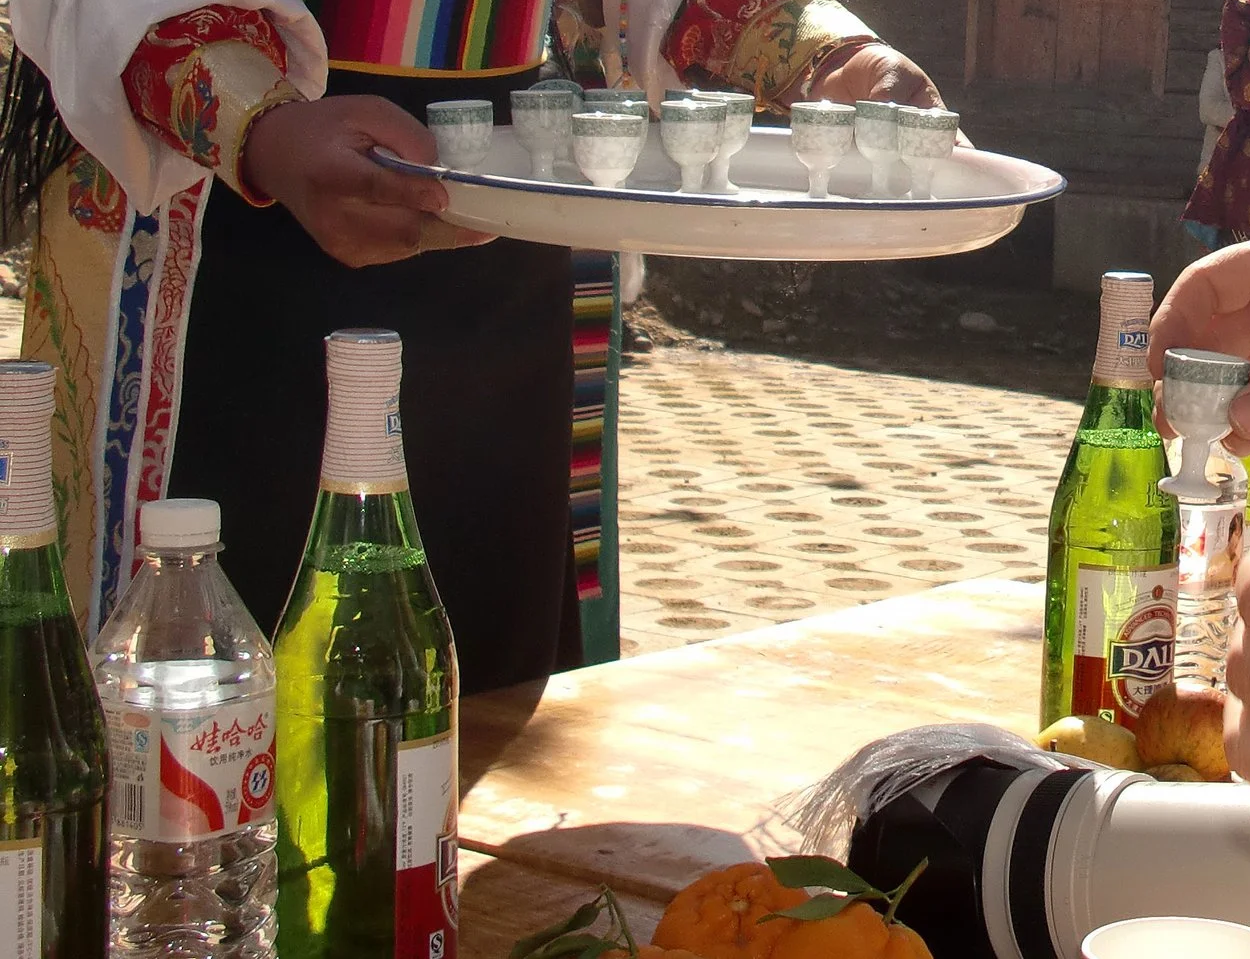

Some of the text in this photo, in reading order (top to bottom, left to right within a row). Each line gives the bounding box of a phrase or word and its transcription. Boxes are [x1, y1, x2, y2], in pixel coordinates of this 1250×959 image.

[190, 713, 267, 754] 娃哈哈
[209, 748, 252, 766] 饮用纯净水
